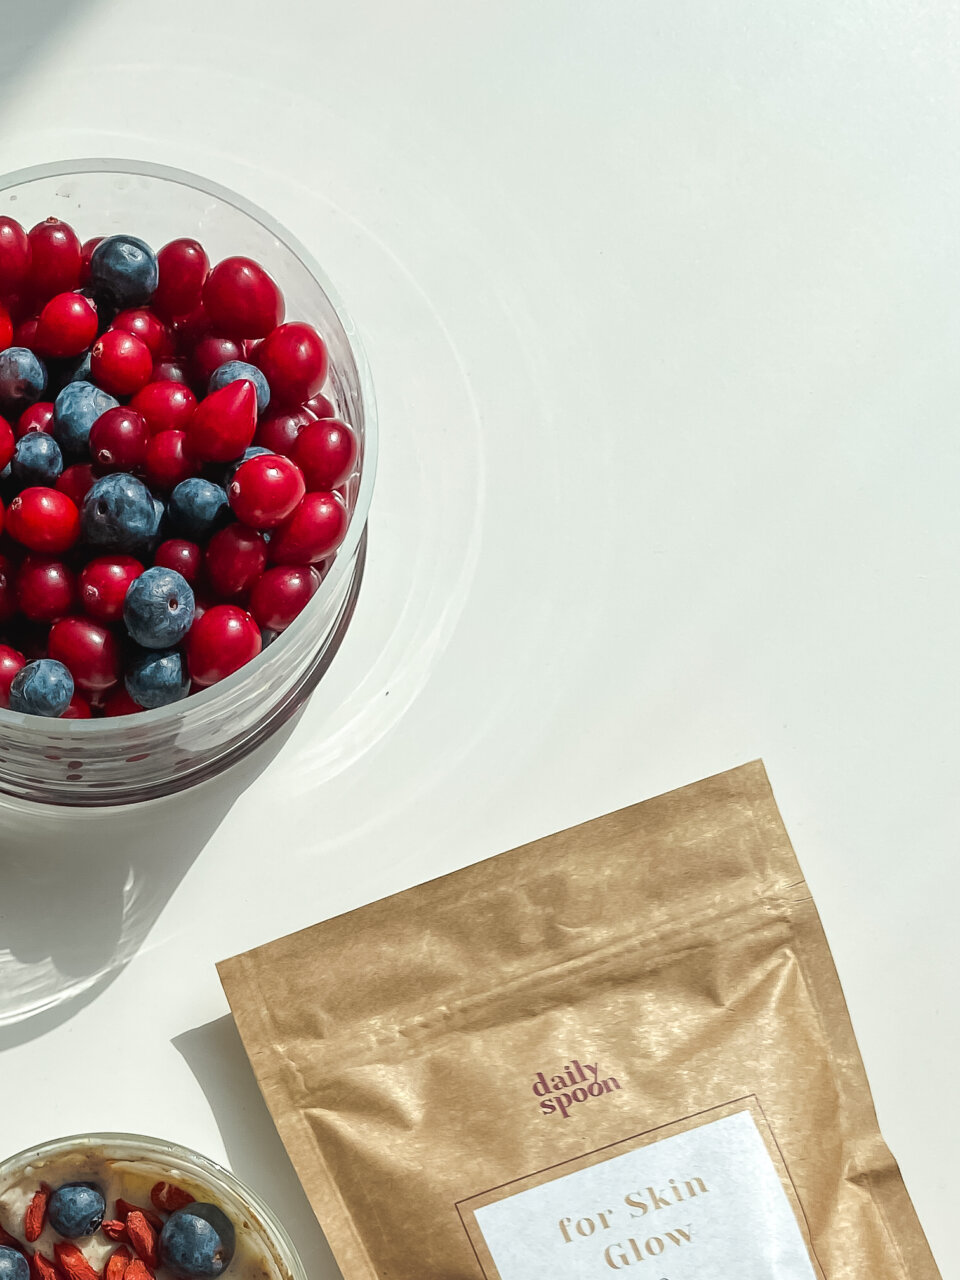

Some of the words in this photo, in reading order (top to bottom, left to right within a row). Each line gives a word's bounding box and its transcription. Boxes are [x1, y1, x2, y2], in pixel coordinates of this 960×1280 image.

[531, 1059, 599, 1097] daily
[539, 1073, 622, 1118] spoon
[557, 1210, 614, 1244] for
[623, 1175, 709, 1219] Skin
[603, 1222, 695, 1271] Glow
